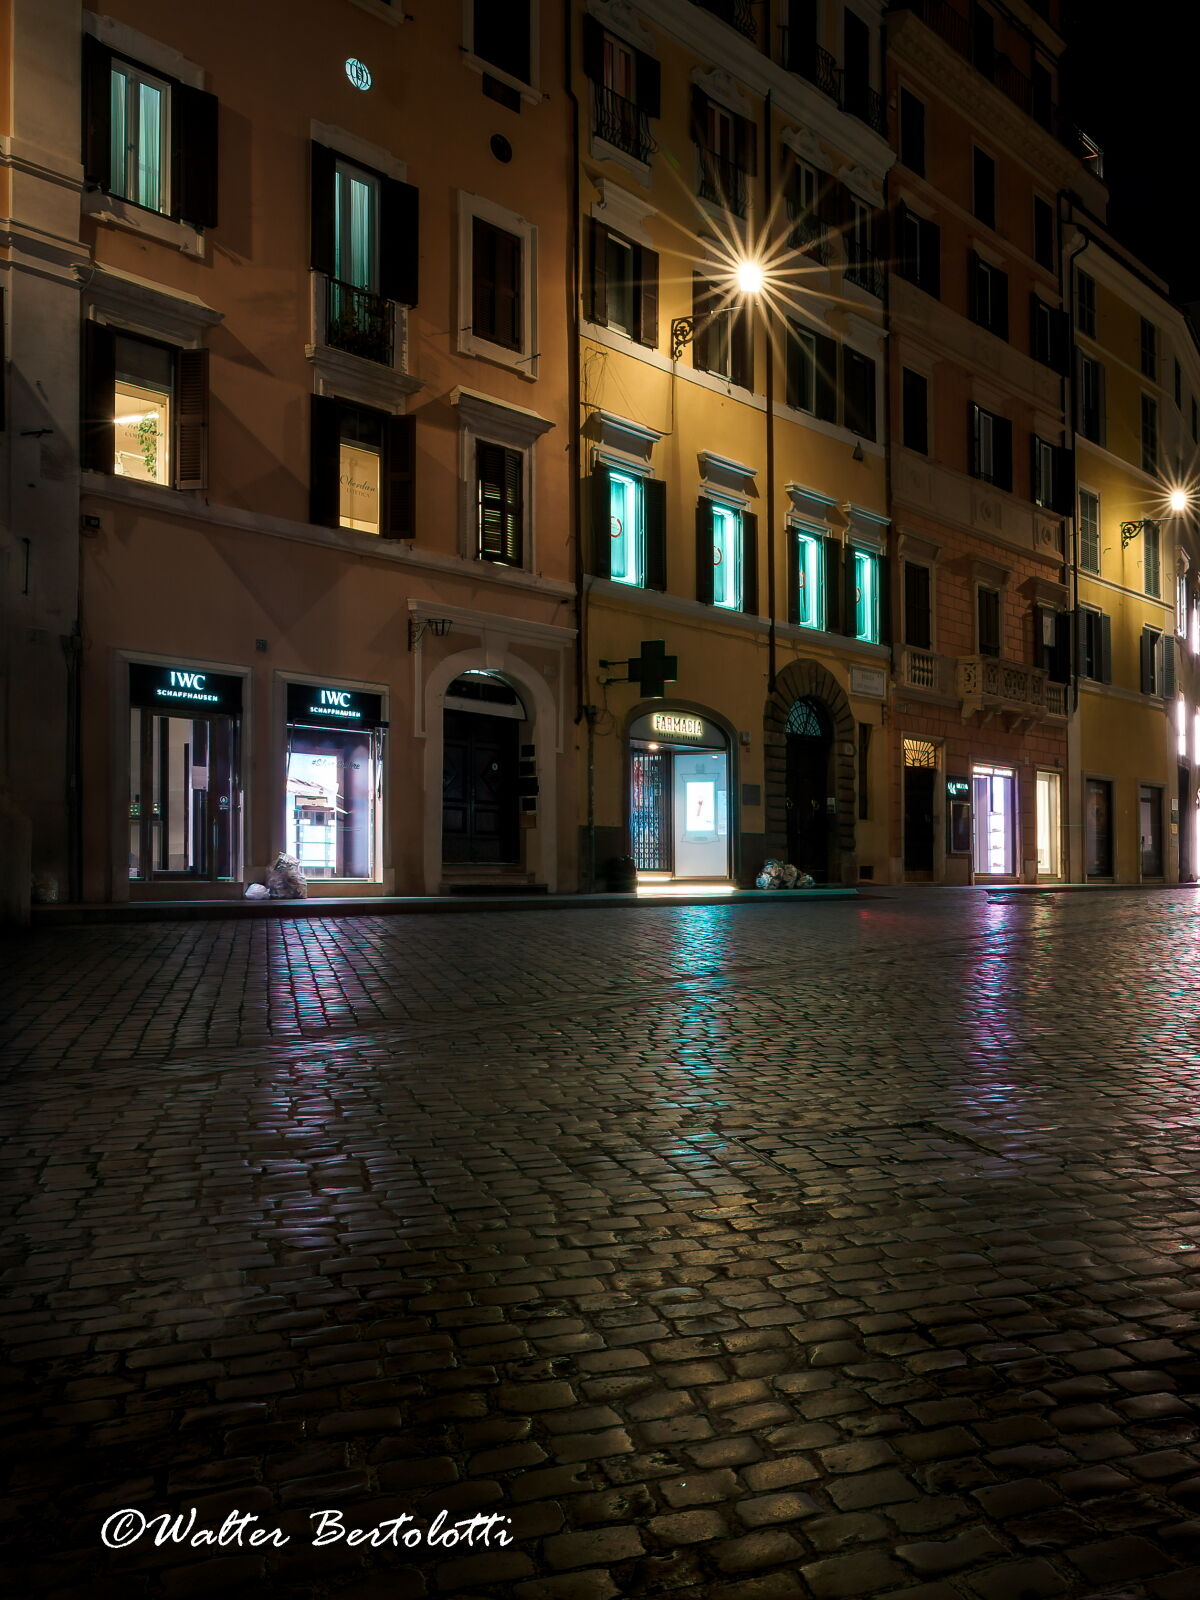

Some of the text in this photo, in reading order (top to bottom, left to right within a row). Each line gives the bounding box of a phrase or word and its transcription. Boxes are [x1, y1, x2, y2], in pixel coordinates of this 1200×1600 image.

[170, 671, 206, 691] IWC
[156, 689, 218, 702] SCHAFFHAUSEN
[320, 689, 351, 708] IWC
[309, 706, 361, 717] SCHAFFHAUSEN
[655, 715, 703, 734] FARMACIA
